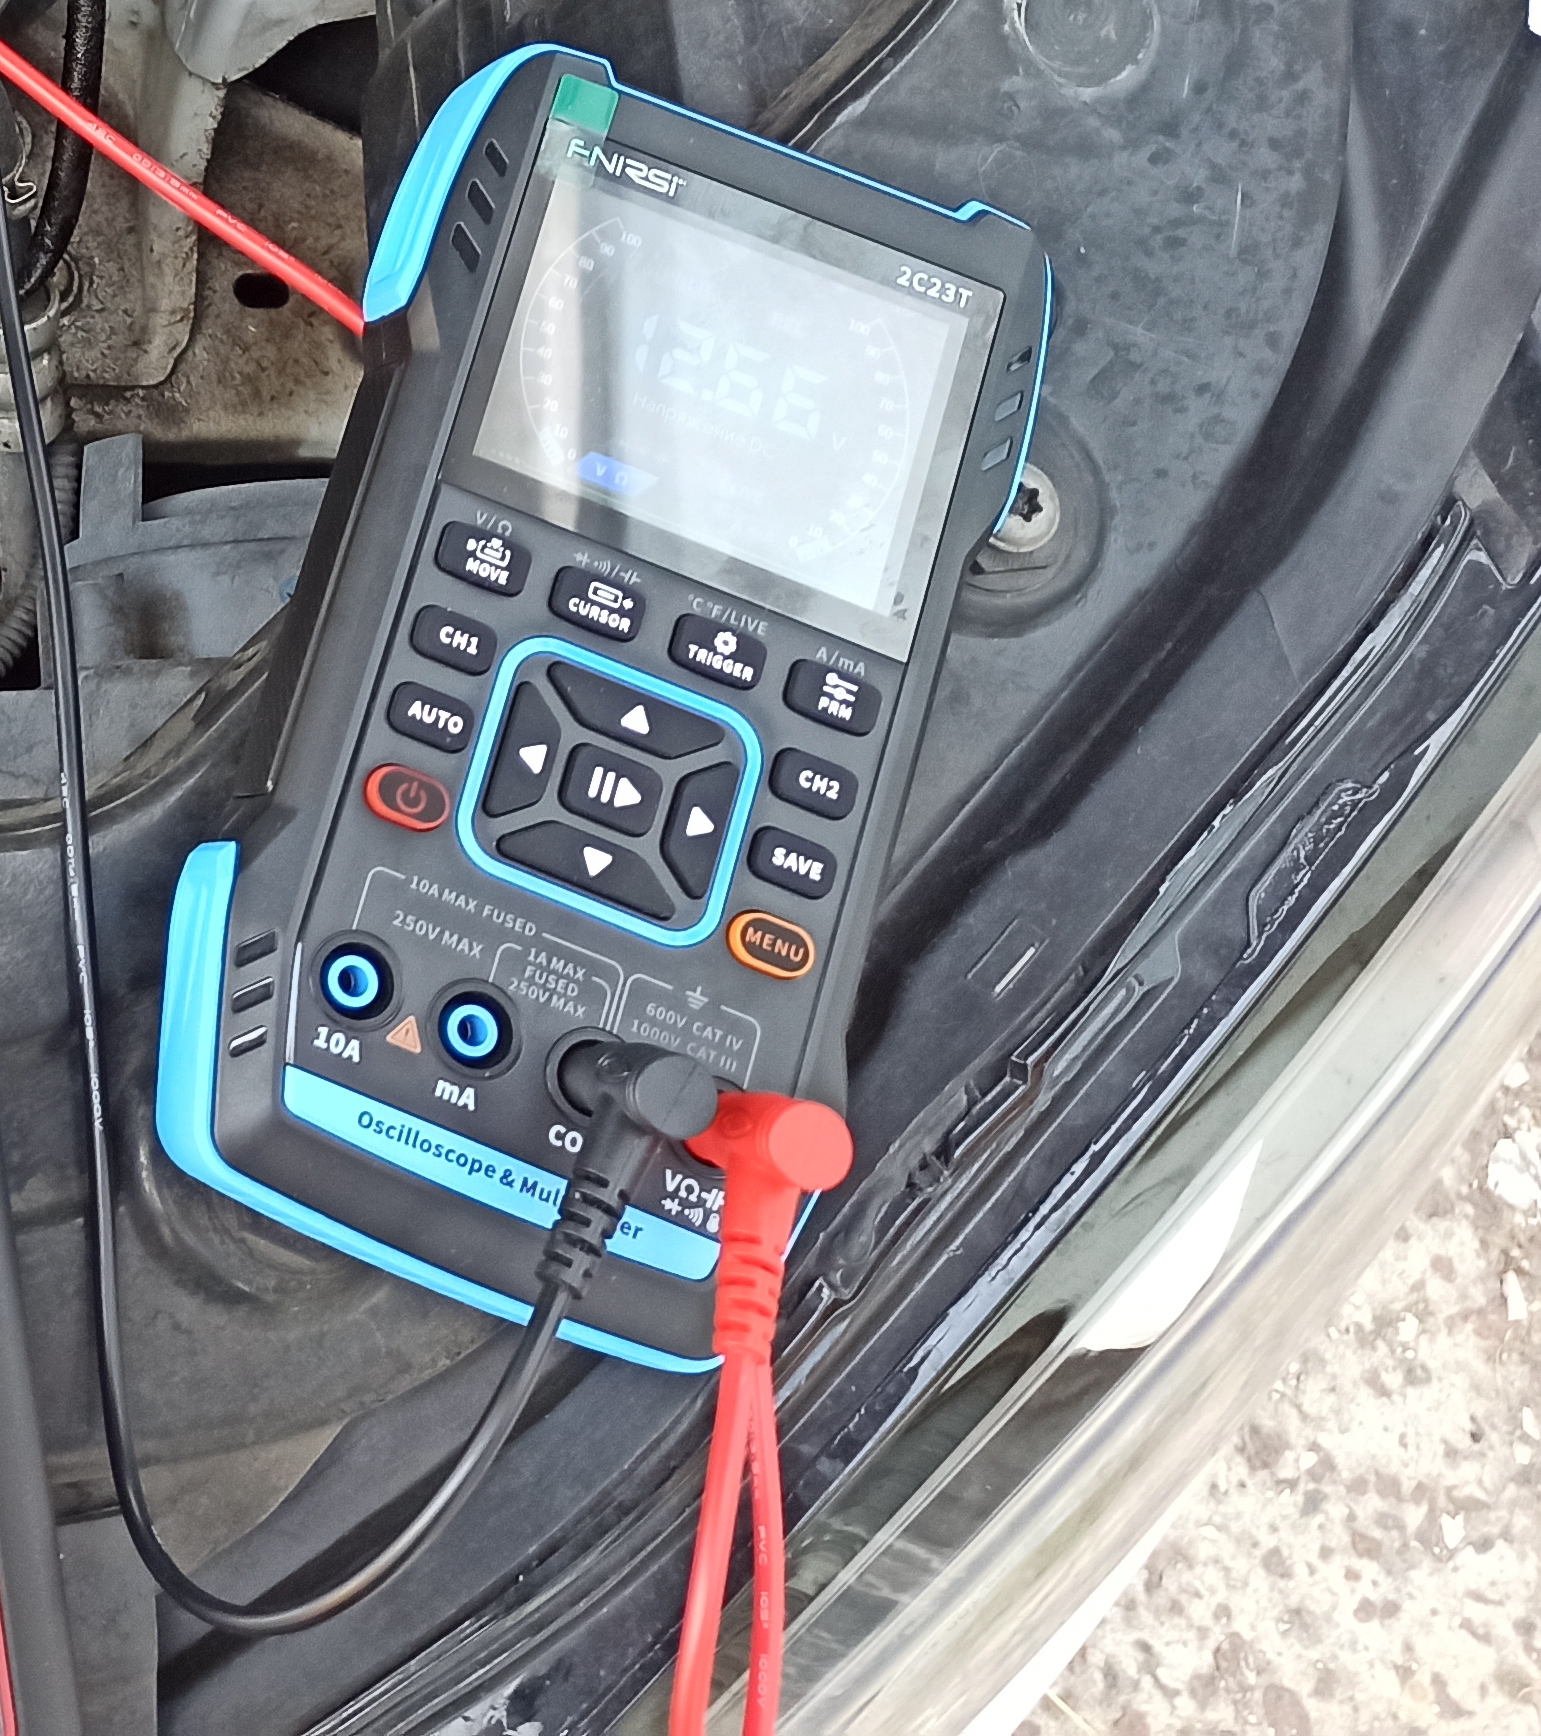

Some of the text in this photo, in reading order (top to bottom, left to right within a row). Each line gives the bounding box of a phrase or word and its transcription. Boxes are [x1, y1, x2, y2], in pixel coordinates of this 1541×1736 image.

[895, 266, 974, 309] 2C23T
[594, 462, 608, 477] V
[465, 557, 510, 586] MOVE
[567, 597, 632, 634] CURSOR
[439, 625, 480, 656] CH1
[687, 643, 755, 683] TRIGGER
[815, 646, 866, 677] A/mA
[407, 700, 464, 735] AUTO
[817, 697, 854, 722] PRM
[797, 769, 841, 801] CH2
[770, 846, 825, 883] SAVE
[409, 875, 537, 937] 10A MAX FUSED
[392, 910, 485, 959] 250V MAX
[745, 924, 805, 965] MENU
[523, 966, 579, 997] FUSED
[527, 947, 586, 981] 1A MAX
[508, 977, 586, 1019] 250V MAX
[313, 1026, 363, 1064] 10A
[645, 1002, 744, 1051] 600V CAT IV
[630, 1019, 738, 1073] 1000V CAT III
[434, 1079, 477, 1112] mA
[356, 1108, 515, 1190] Oscilloscope &
[547, 1124, 584, 1154] CO
